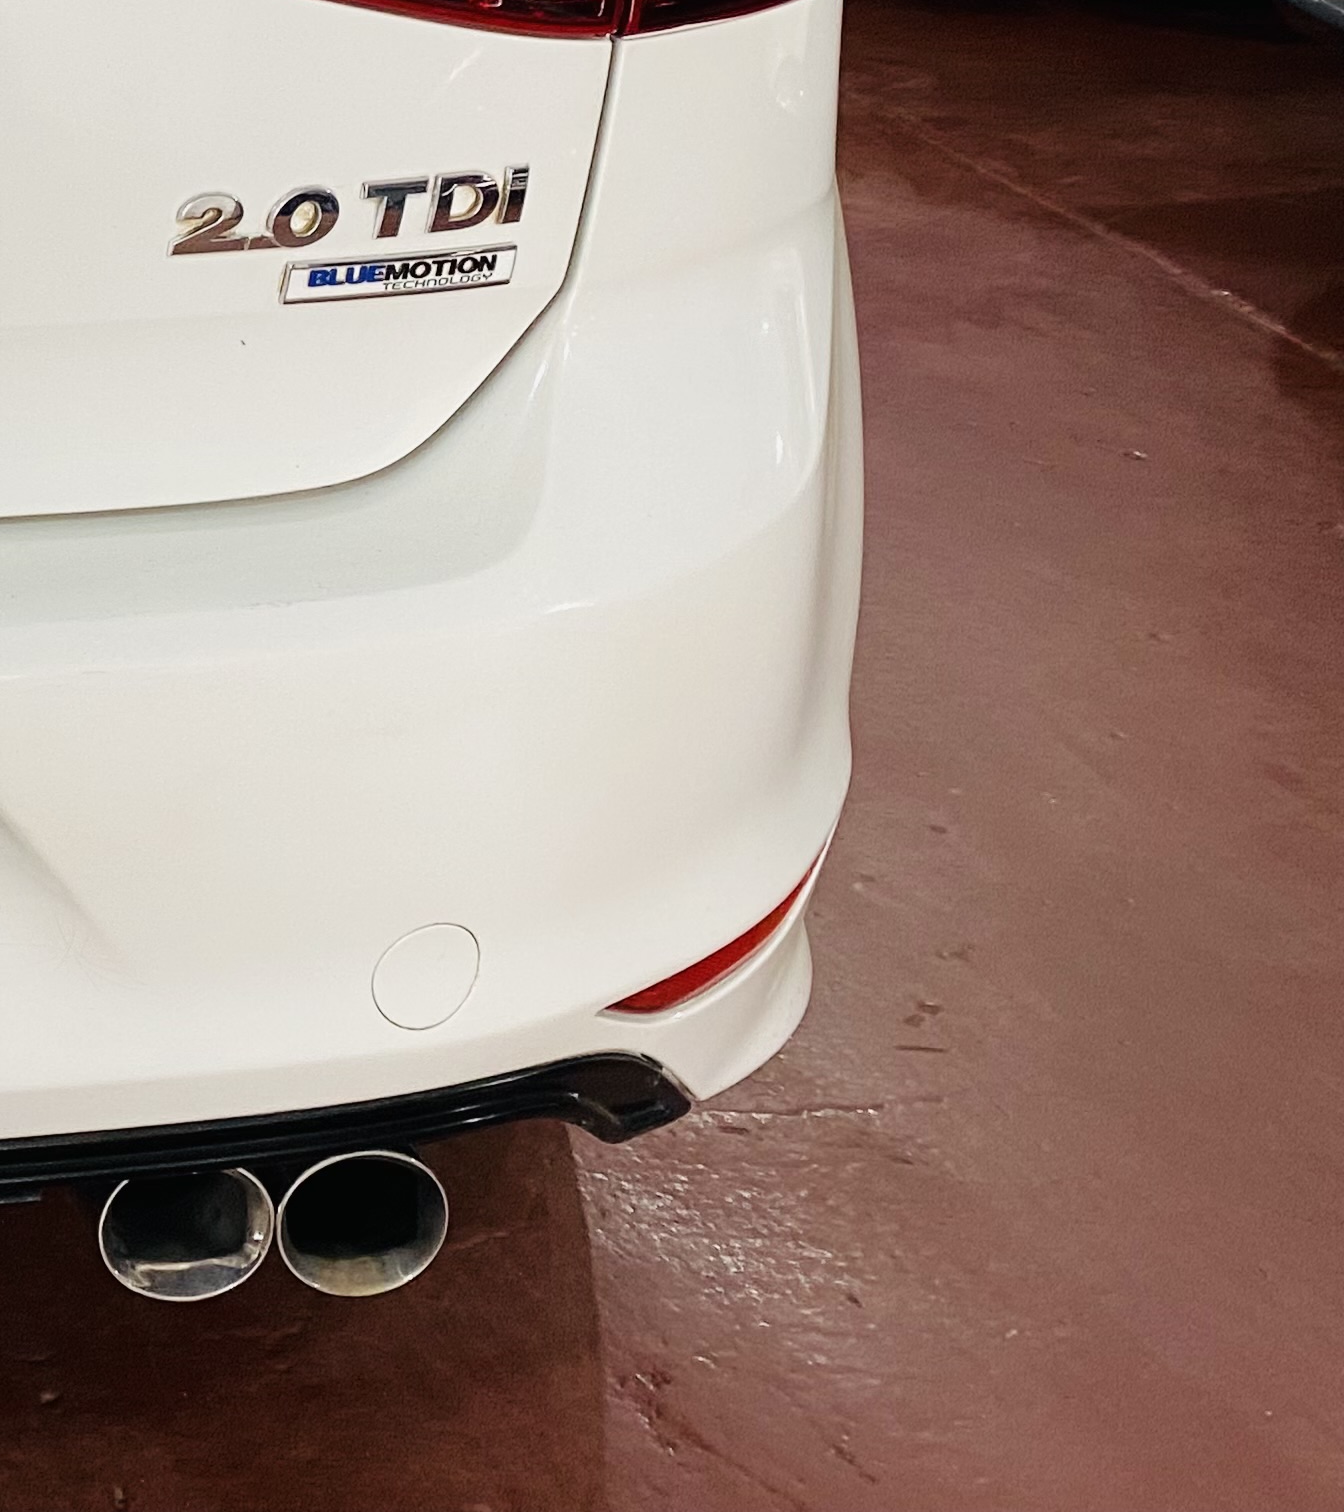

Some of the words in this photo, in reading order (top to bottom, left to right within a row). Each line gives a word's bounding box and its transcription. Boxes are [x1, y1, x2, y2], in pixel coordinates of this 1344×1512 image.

[167, 184, 340, 256] 2.0
[307, 254, 497, 288] BLUEMOTION
[383, 271, 494, 291] TECHNOLOGY
